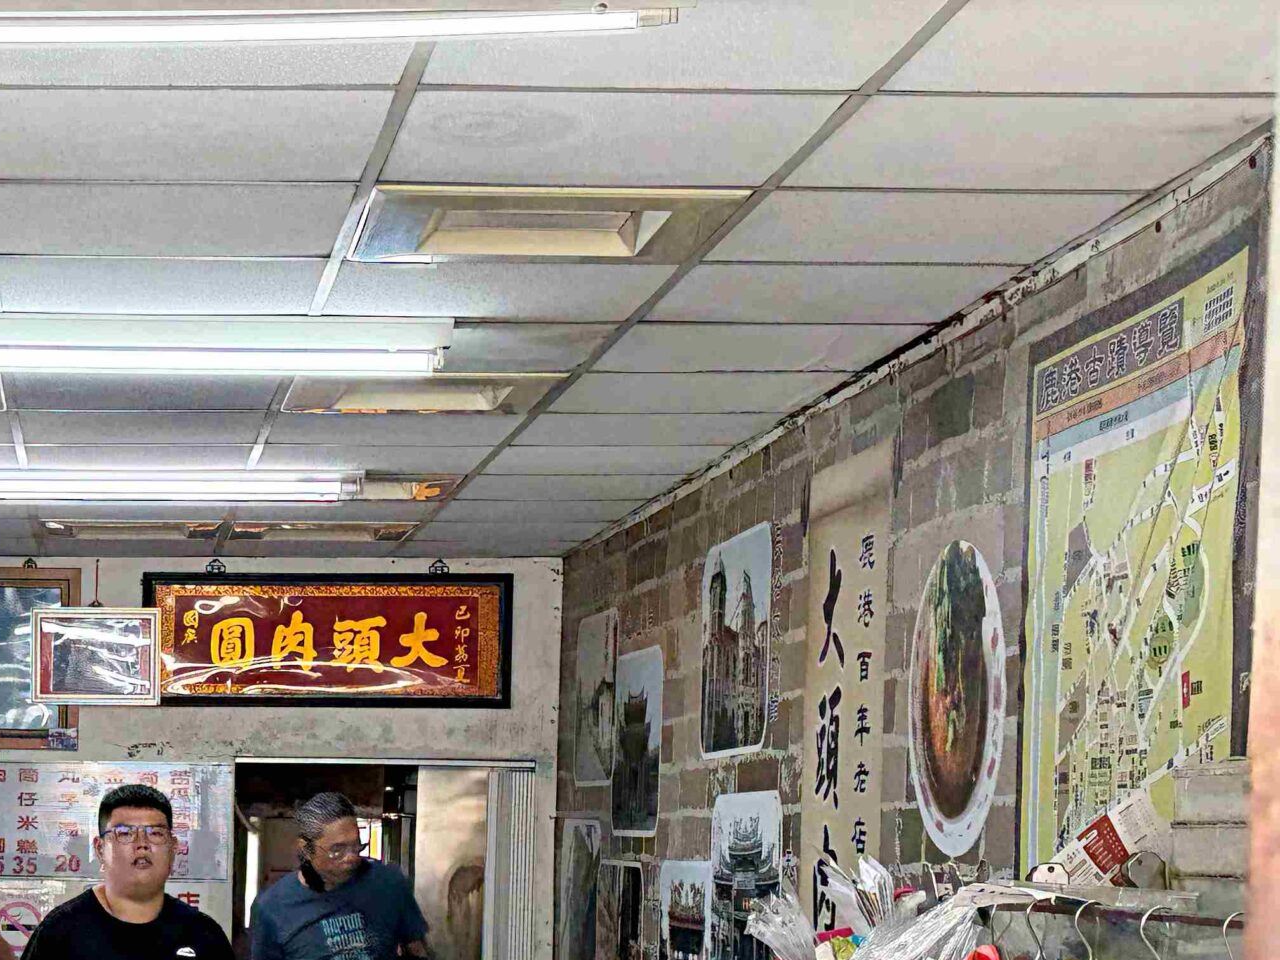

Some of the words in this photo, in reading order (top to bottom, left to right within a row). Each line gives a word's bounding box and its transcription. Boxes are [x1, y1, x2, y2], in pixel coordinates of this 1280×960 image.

[1040, 303, 1180, 411] 鹿港古蹟導覽
[210, 609, 449, 673] 大頭肉圓
[851, 534, 875, 854] 鹿港百年老店
[12, 855, 38, 875] 35
[54, 854, 81, 873] 20
